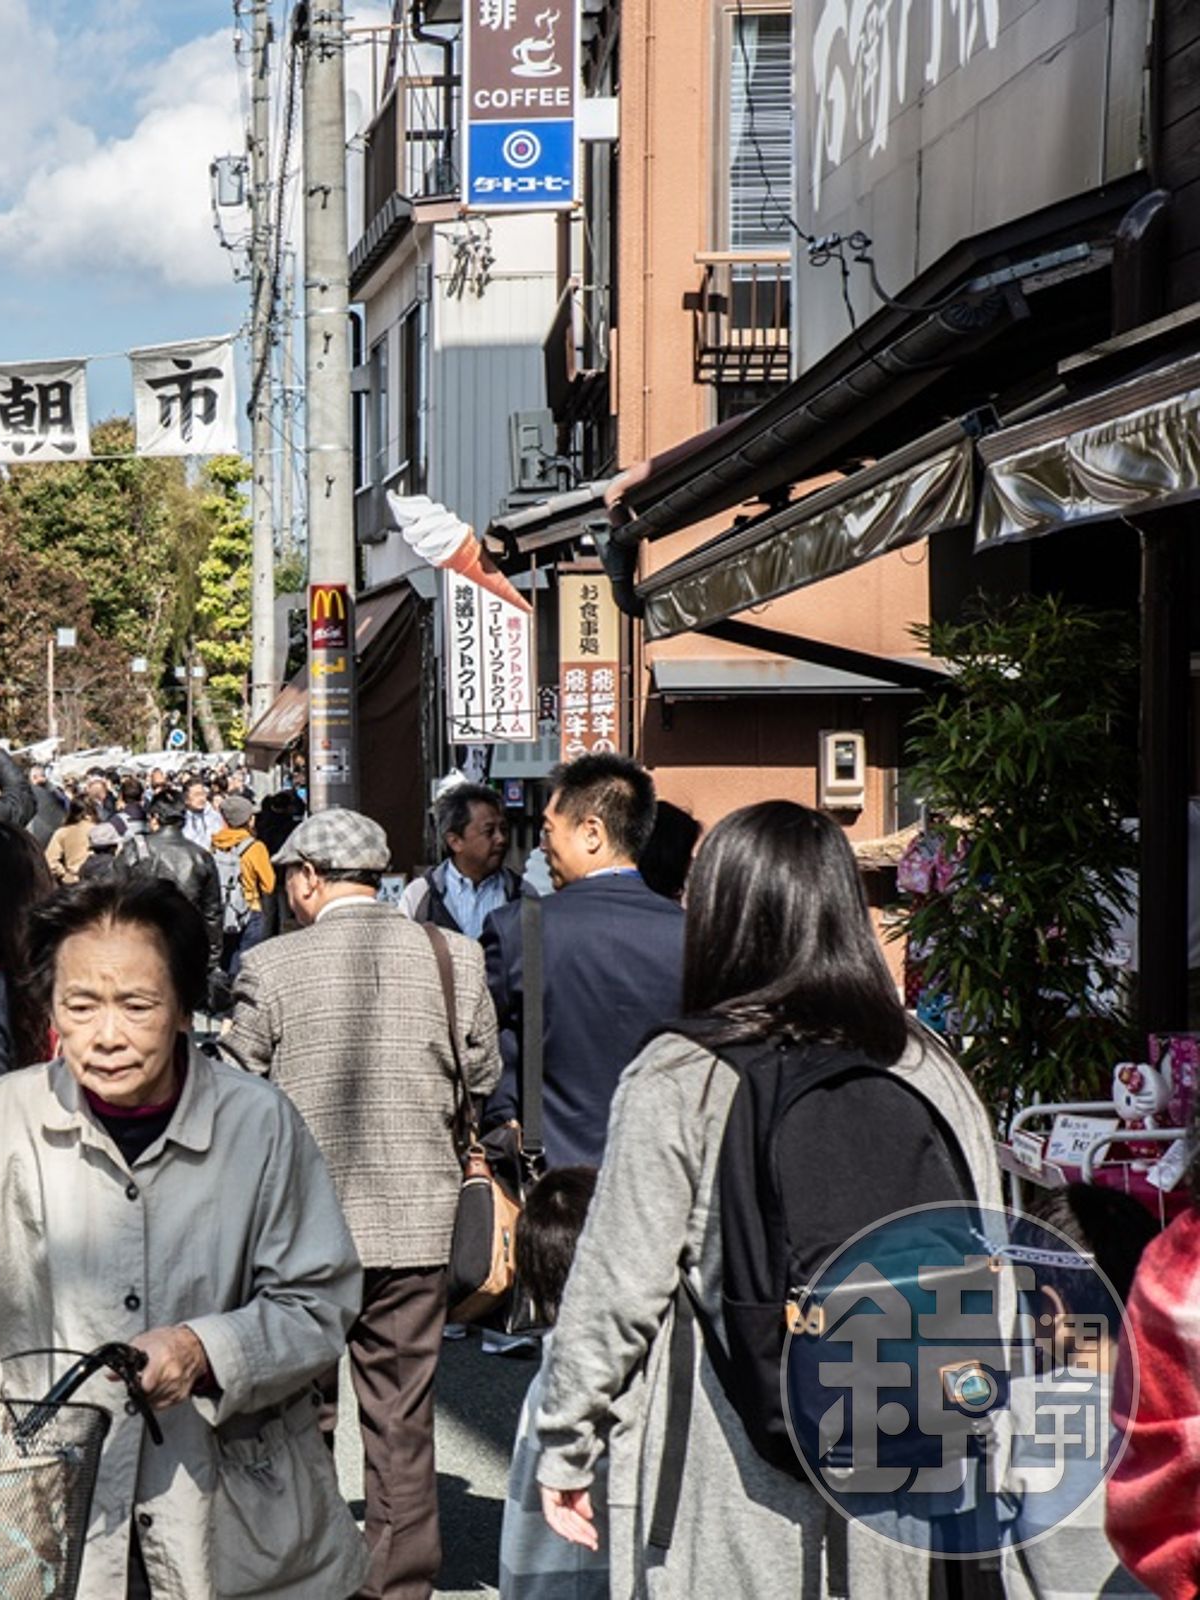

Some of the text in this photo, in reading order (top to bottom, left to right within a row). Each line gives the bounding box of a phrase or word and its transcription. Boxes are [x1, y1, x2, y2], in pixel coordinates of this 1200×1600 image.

[474, 87, 570, 109] COFFEE
[473, 176, 570, 193] ダートコーヒー
[579, 584, 600, 655] お食事処
[455, 584, 477, 735] 地酒ソフトクリーム
[489, 601, 507, 733] コーヒーソフトクリーム
